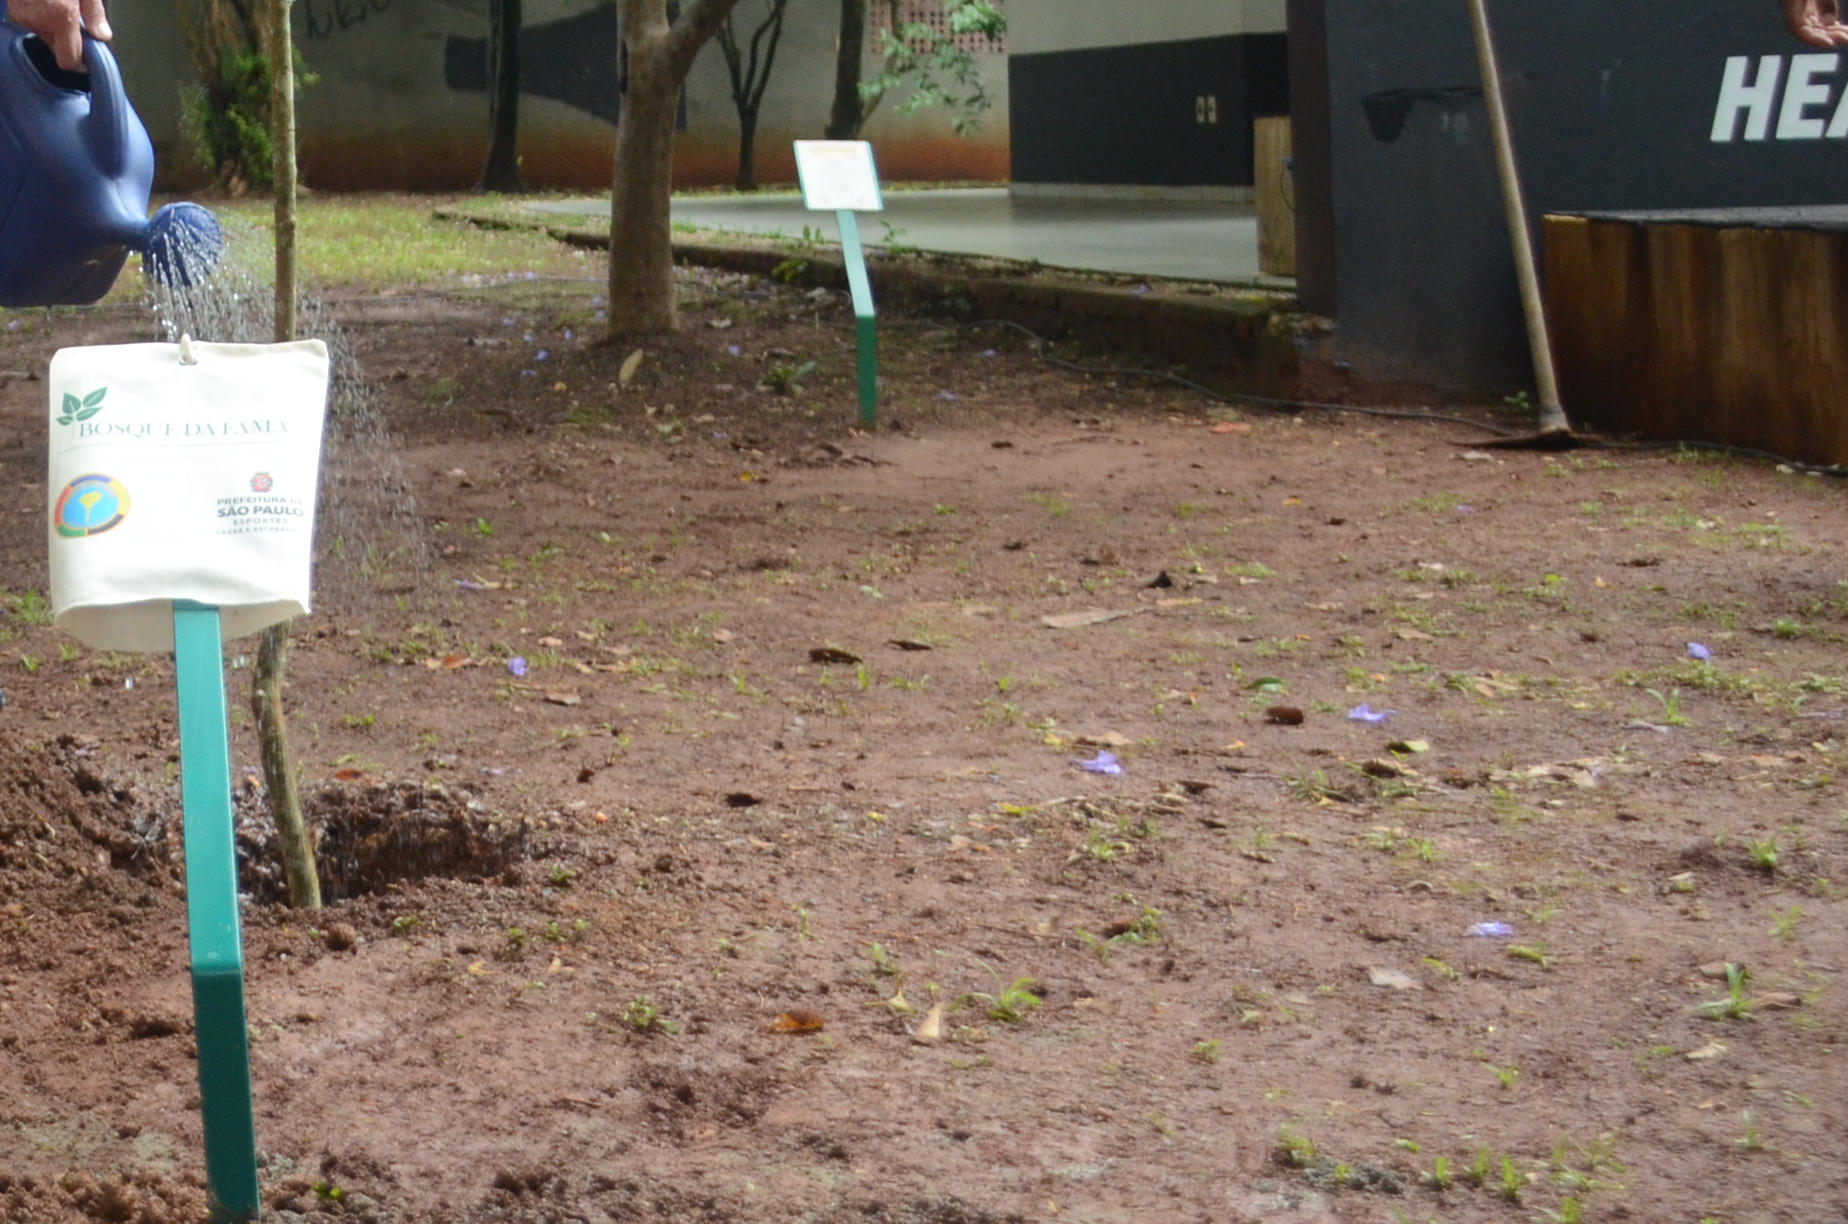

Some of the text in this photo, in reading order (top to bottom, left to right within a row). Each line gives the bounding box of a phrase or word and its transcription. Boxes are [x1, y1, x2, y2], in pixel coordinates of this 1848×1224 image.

[79, 419, 288, 438] BOSQUE DA FAMA
[217, 496, 287, 505] PREFEITURA
[217, 504, 304, 518] SÃO PAULO
[233, 517, 288, 526] ESPORTES
